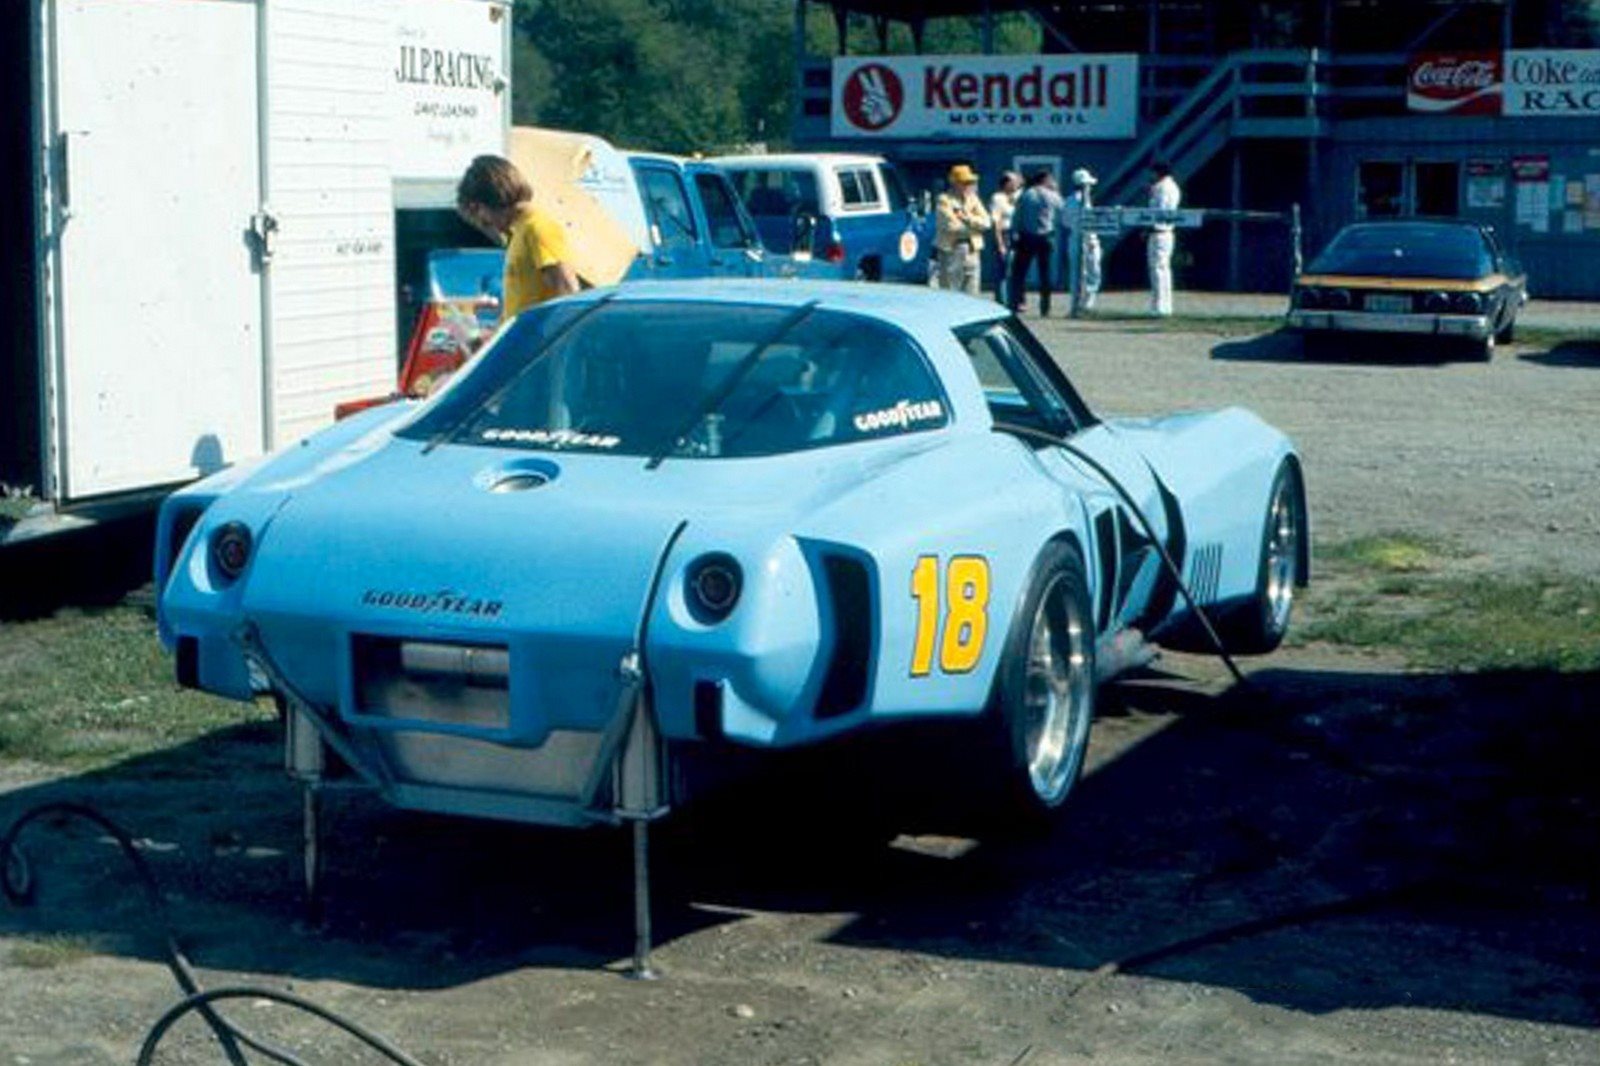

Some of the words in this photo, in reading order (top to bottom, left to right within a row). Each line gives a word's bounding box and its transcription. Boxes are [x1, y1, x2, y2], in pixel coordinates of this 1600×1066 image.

[1512, 57, 1577, 86] Coke
[924, 65, 1107, 109] Kendall
[950, 112, 1033, 124] MOTOR
[1050, 112, 1088, 124] OIL
[854, 400, 942, 430] GOODYEAR
[482, 428, 620, 448] GOODYEAR
[362, 589, 503, 617] GOODYEAR
[909, 553, 990, 677] 18
